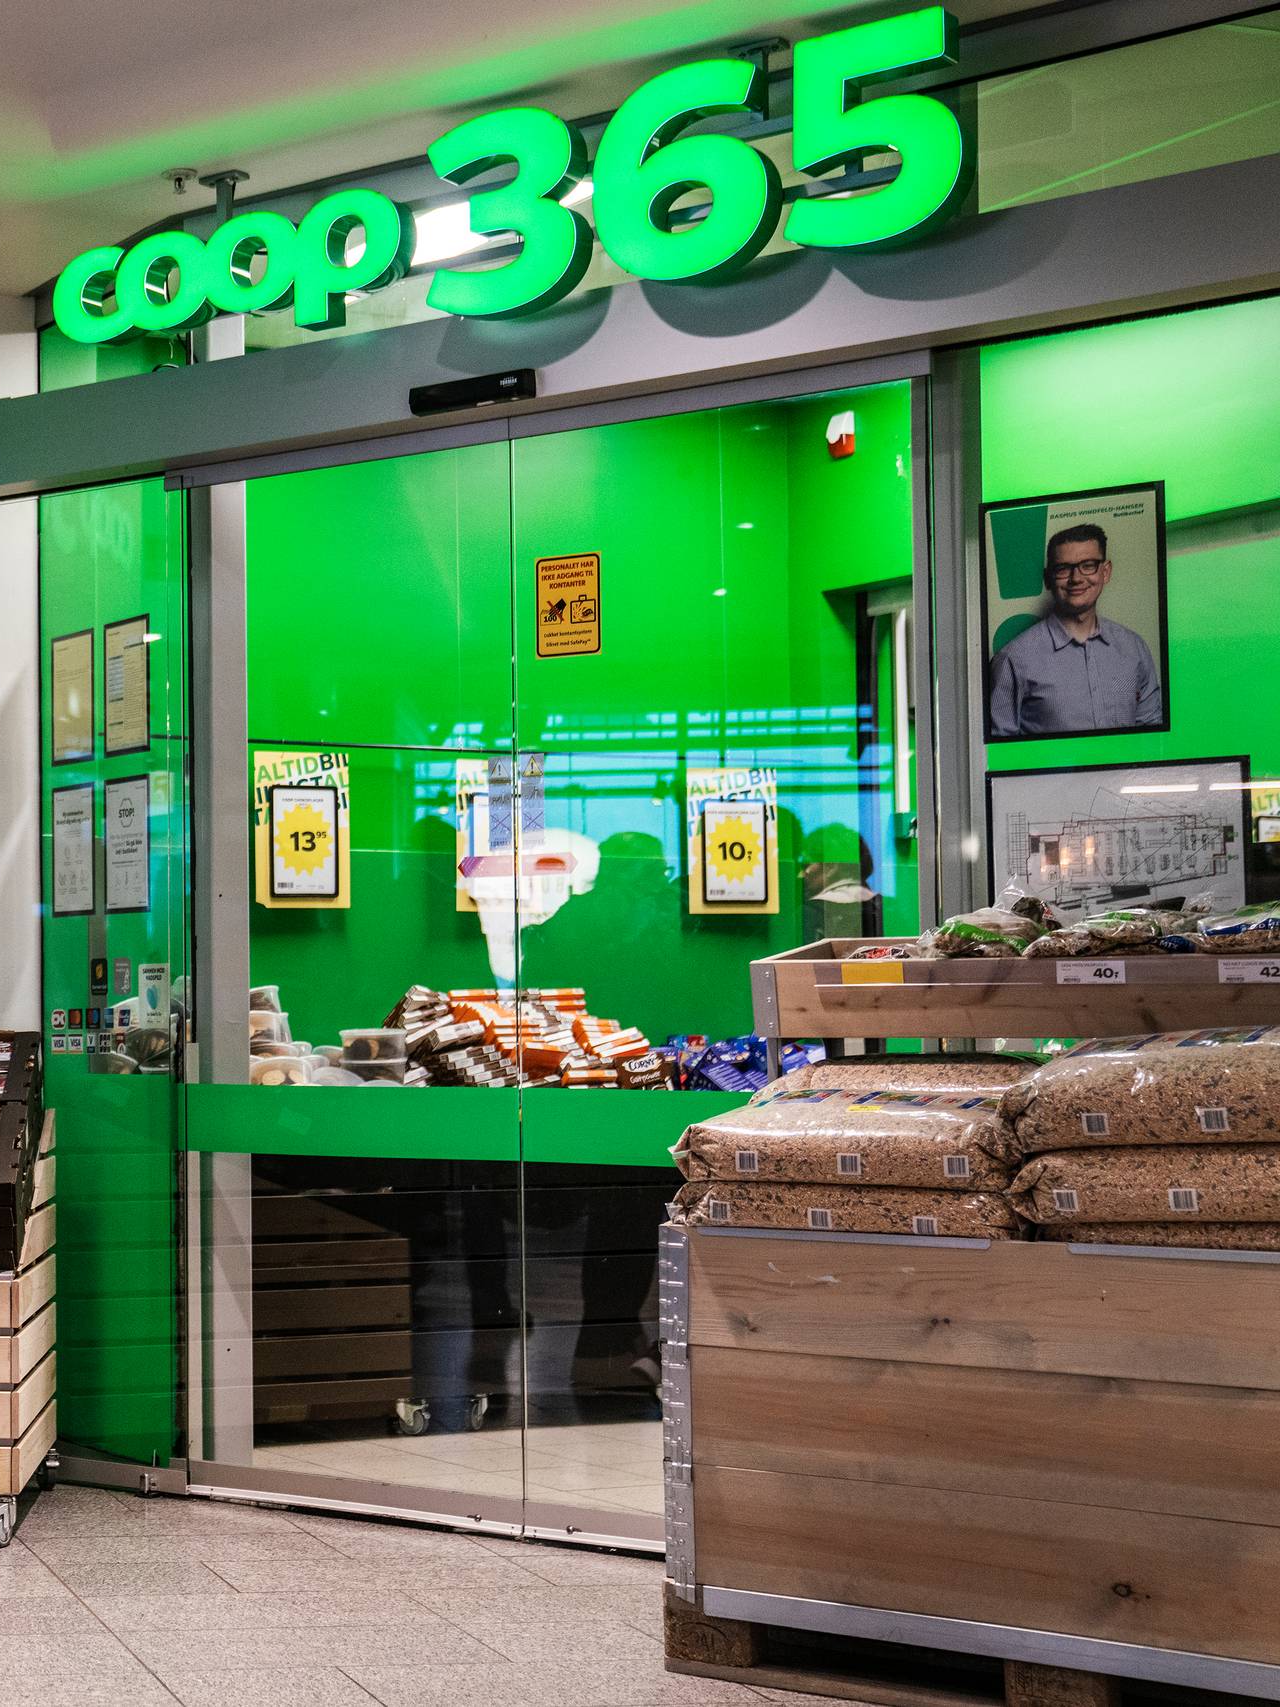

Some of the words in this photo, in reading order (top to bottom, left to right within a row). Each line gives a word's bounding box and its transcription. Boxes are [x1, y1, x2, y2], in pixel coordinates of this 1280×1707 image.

[53, 189, 408, 343] coop
[426, 6, 963, 317] 365
[541, 562, 580, 573] PERSONALET
[580, 560, 594, 569] HAR
[541, 573, 556, 582] IKKE
[556, 571, 585, 581] ADGANG
[549, 580, 586, 590] KONTANTER
[118, 807, 134, 819] STOP!
[53, 1039, 64, 1048] VISA
[70, 1038, 81, 1047] VISA
